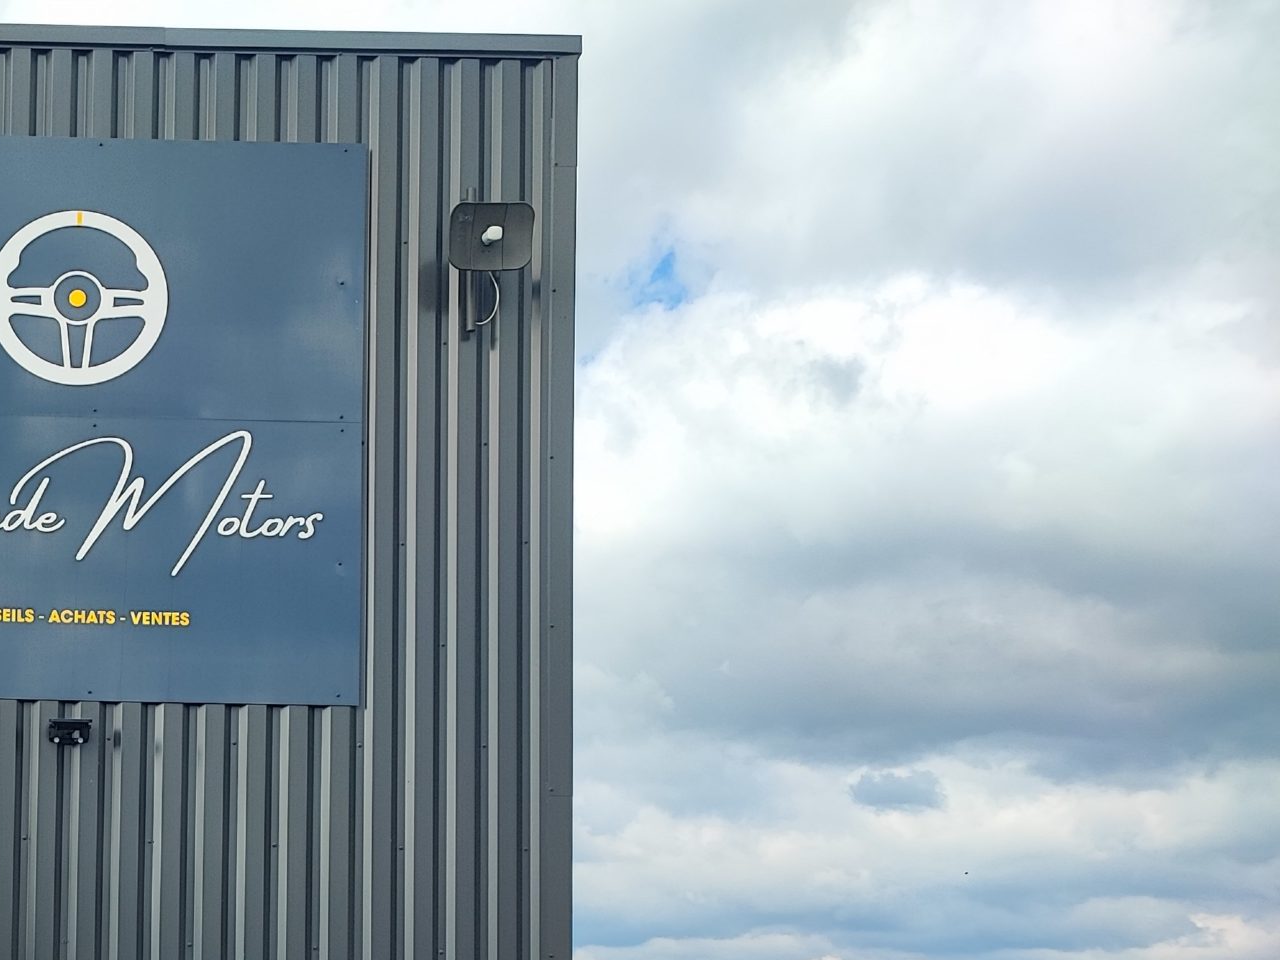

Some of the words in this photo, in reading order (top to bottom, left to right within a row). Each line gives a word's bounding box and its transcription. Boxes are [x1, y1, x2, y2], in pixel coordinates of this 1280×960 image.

[10, 430, 324, 577] Motors
[47, 608, 117, 625] ACHATS
[129, 610, 191, 626] VENTES
